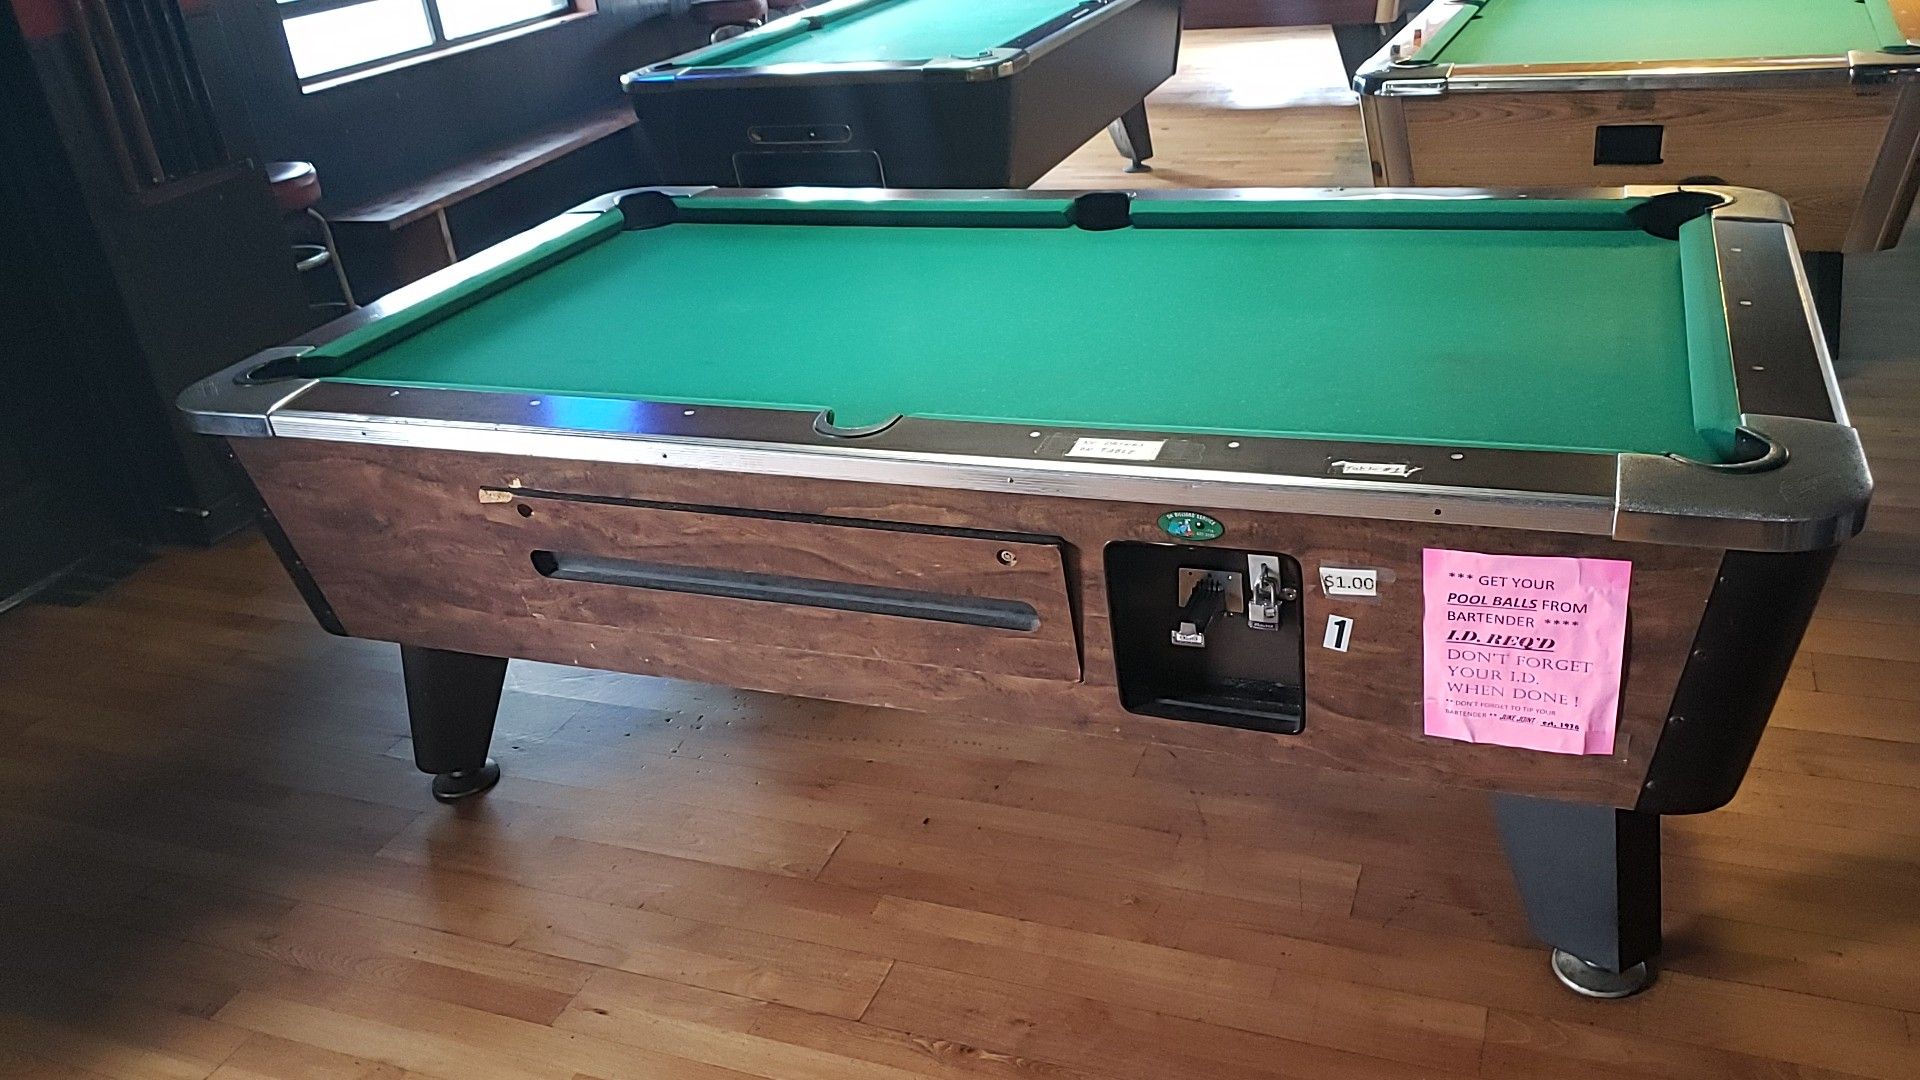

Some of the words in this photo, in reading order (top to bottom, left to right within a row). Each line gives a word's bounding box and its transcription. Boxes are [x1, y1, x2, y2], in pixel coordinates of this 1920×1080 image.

[1324, 574, 1374, 590] $1.00
[1478, 575, 1508, 587] GET
[1511, 577, 1555, 591] YOUR
[1447, 592, 1488, 605] POOL
[1492, 596, 1538, 610] BALLS
[1542, 600, 1588, 614] FROM
[1447, 610, 1535, 628] BARTENDER
[1334, 619, 1347, 649] 1
[1447, 629, 1481, 643] I.D.
[1486, 632, 1556, 650] REQ'D
[1447, 648, 1510, 665] DON'T
[1516, 655, 1594, 673] FORGET
[1447, 665, 1502, 681] YOUR
[1510, 671, 1540, 685] I.D.
[1447, 682, 1504, 697] WHEN
[1513, 688, 1568, 706] DONE
[1445, 708, 1487, 718] BARTENDER
[1480, 701, 1508, 710] FORGET
[1535, 708, 1556, 716] YOUR
